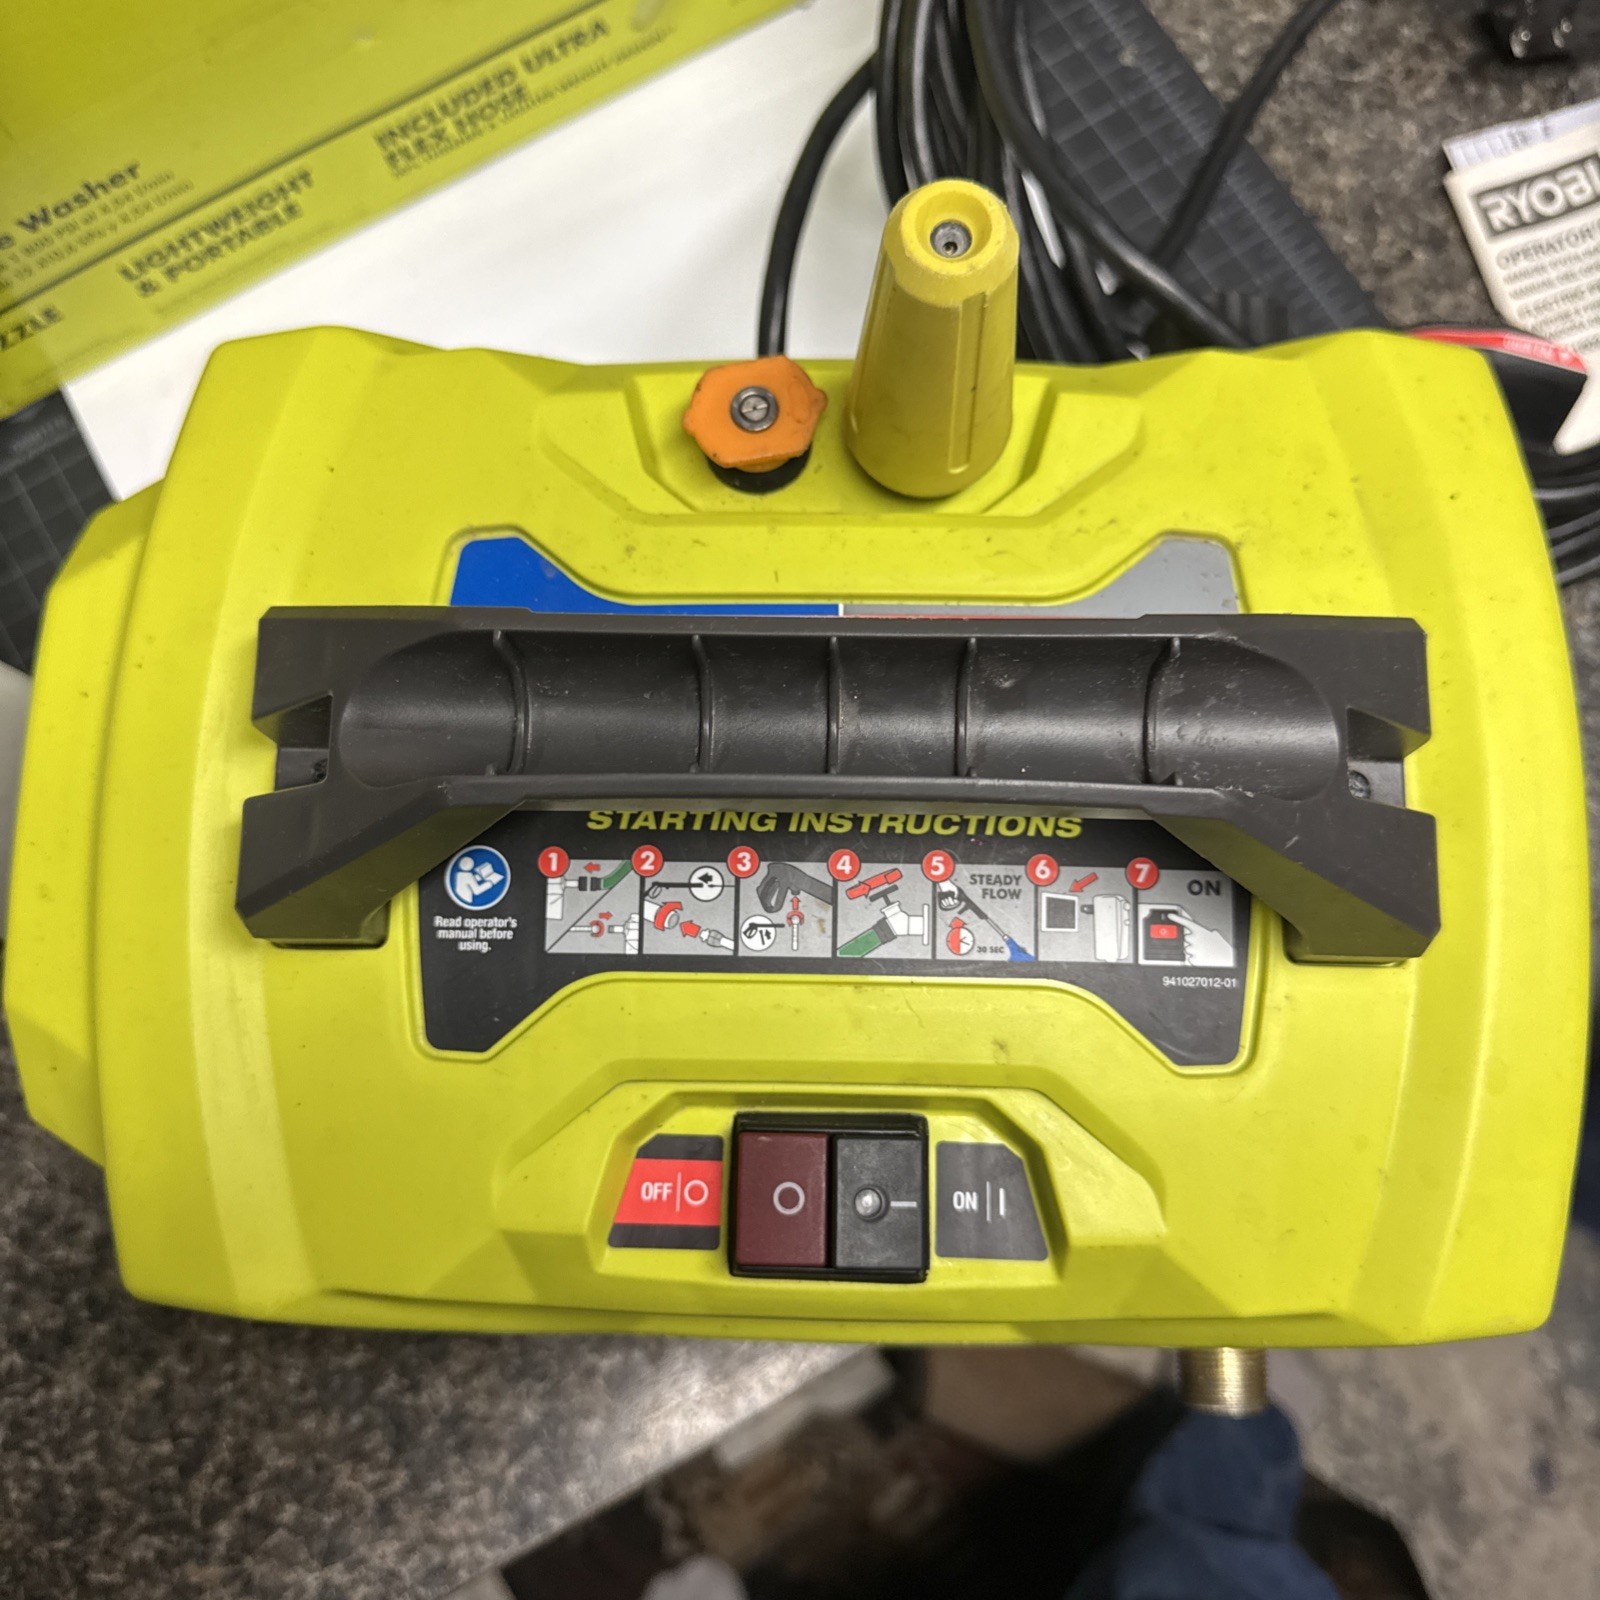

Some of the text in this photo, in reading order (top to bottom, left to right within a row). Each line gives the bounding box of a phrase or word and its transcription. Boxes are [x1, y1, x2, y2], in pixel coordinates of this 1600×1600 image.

[17, 162, 140, 233] Washer
[118, 168, 314, 282] LIGHTWEIGHT
[162, 200, 304, 283] PORTABLE
[1496, 219, 1600, 270] OPERATOR'
[586, 810, 1082, 838] STARTING INSTRUCTIONS
[548, 852, 1149, 883] 1 2 3 4 5 6 7
[969, 873, 1022, 887] STEADY
[1187, 879, 1221, 896] ON
[981, 887, 1022, 900] FLOW
[433, 915, 517, 929] Read operator's
[436, 928, 514, 939] manual before
[457, 940, 492, 954] using.
[1162, 976, 1237, 987] 941027012-01
[640, 1182, 672, 1201] OFF
[952, 1190, 977, 1210] ON
